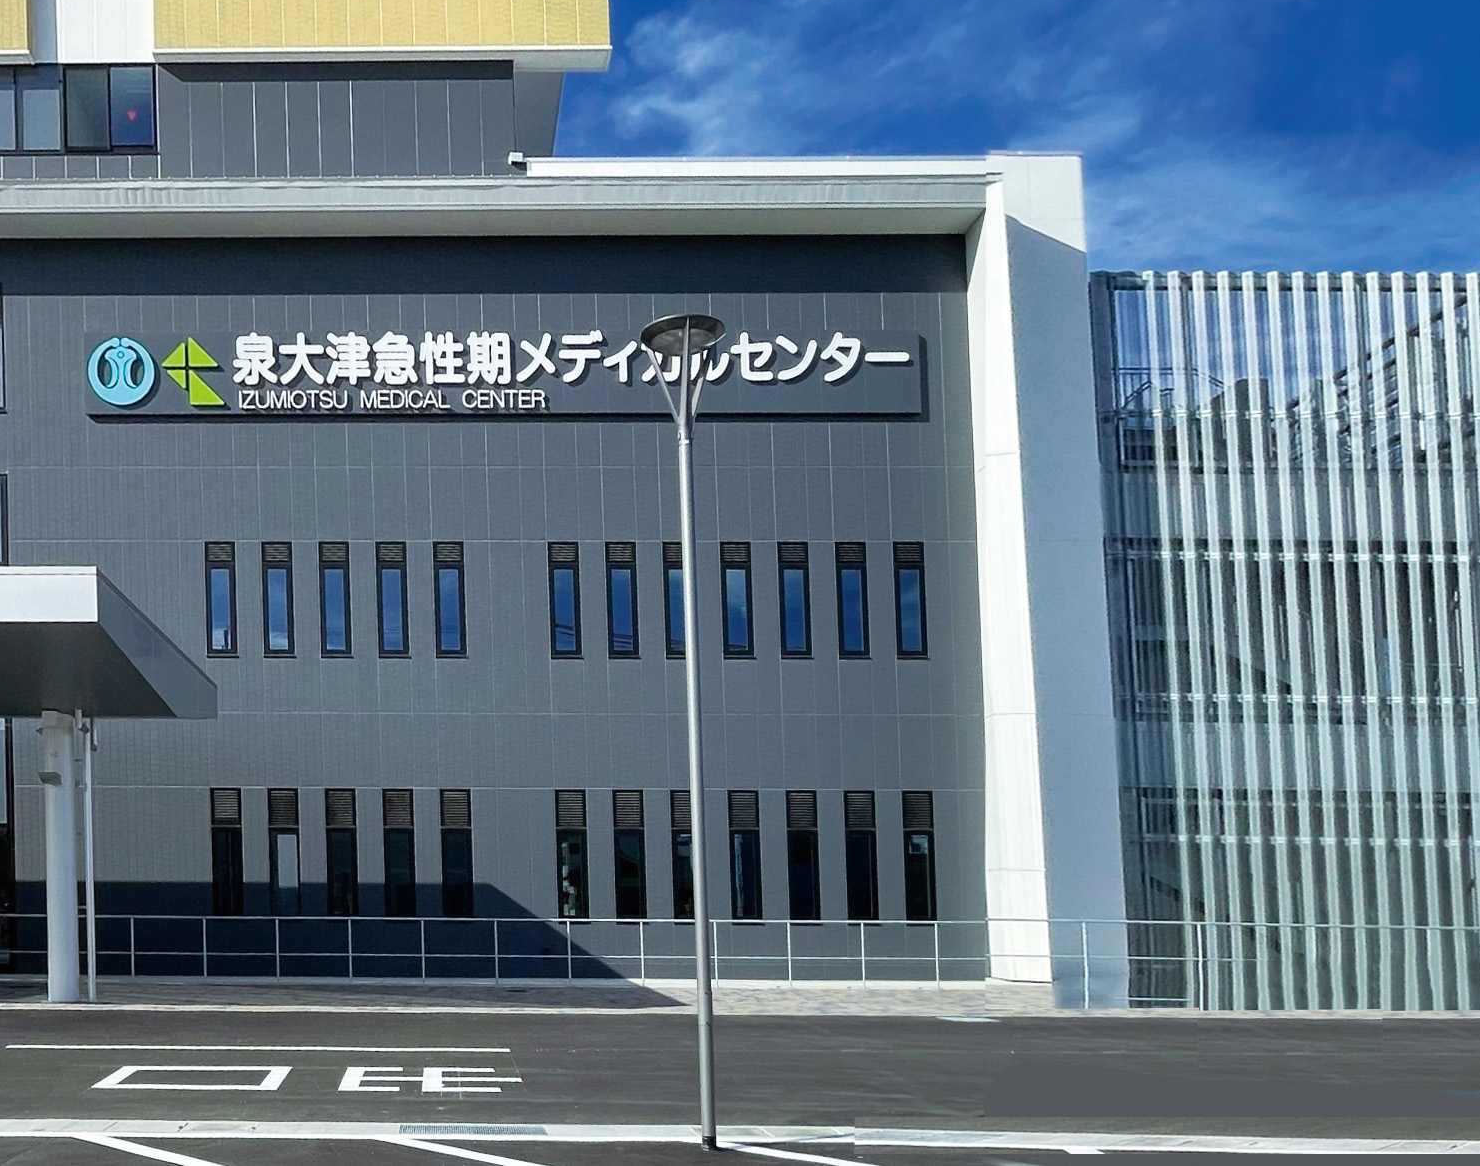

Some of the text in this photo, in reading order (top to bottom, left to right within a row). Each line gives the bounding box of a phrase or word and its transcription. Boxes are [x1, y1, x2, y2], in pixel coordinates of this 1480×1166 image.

[238, 389, 546, 409] IZUMIOTSU MEDICAL CENTER
